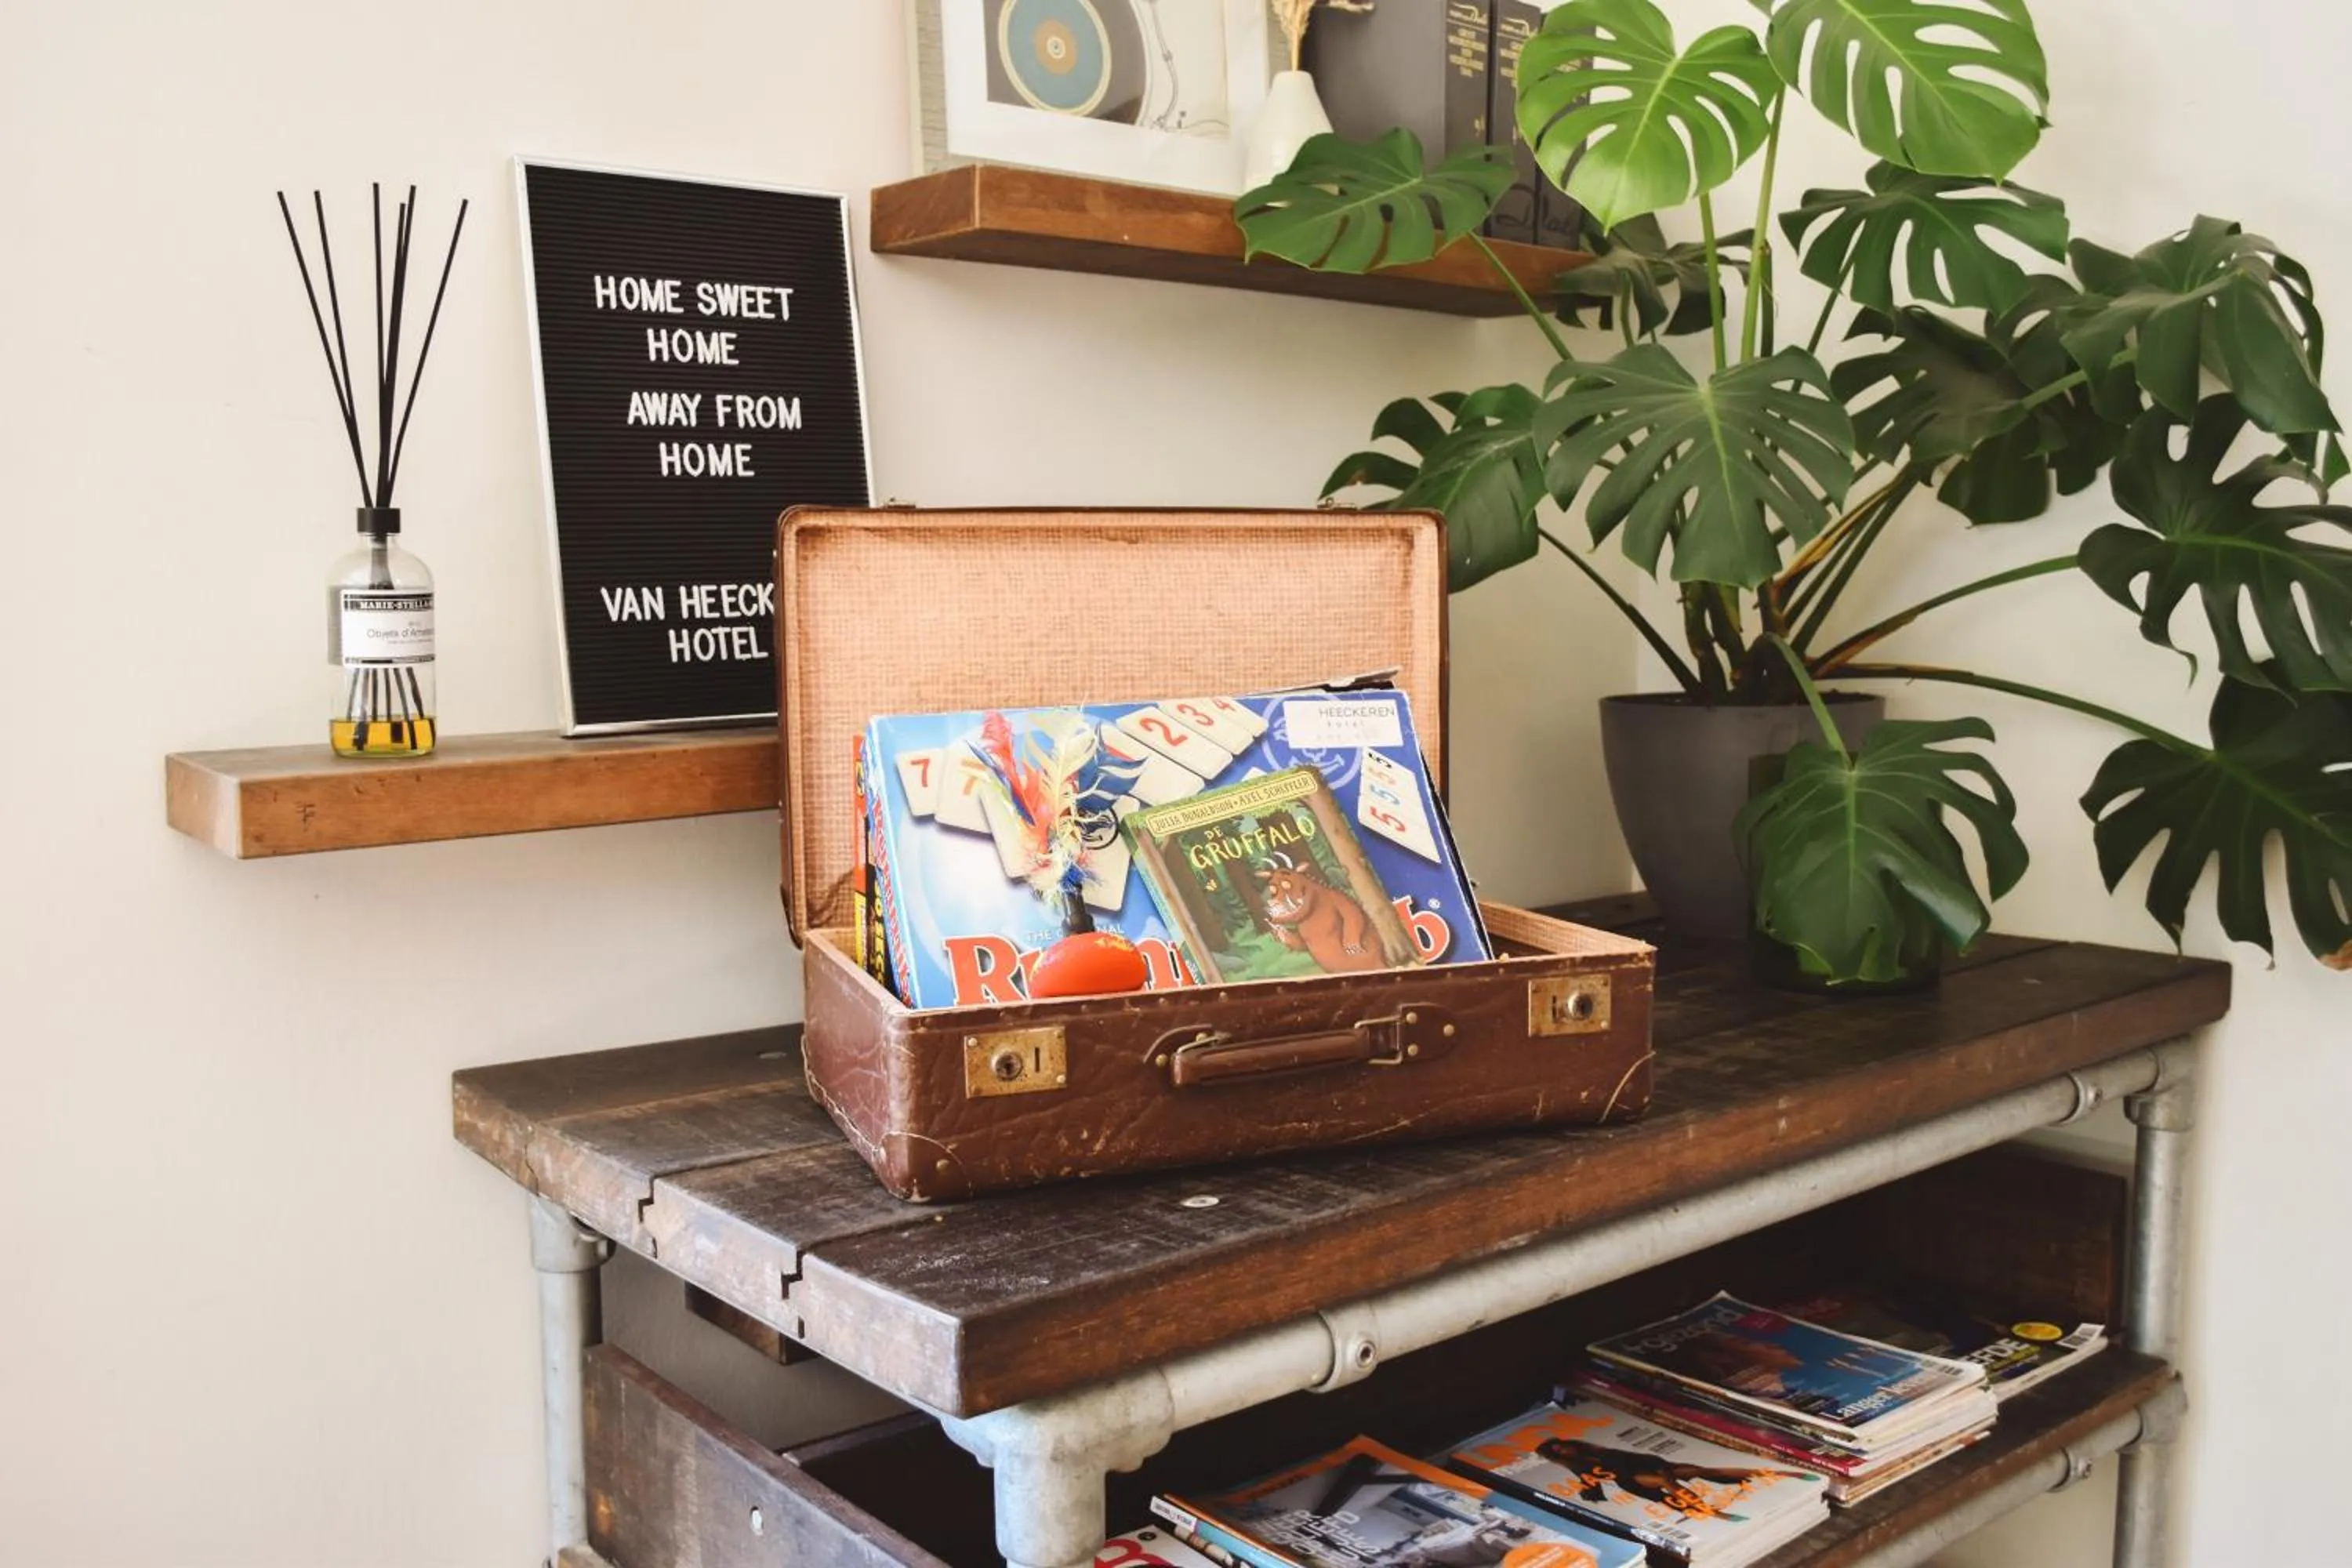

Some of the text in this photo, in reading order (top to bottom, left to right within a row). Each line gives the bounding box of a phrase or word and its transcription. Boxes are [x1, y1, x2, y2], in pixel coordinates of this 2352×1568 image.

[593, 275, 793, 320] HOME SWEET
[647, 328, 739, 365] HOME
[627, 392, 801, 430] AWAY FROM
[659, 443, 754, 477] HOME
[601, 586, 665, 622] VAN
[669, 626, 768, 662] HOTEL
[1139, 717, 1188, 747] 2
[1177, 703, 1214, 727] 3
[1319, 706, 1395, 717] HEECKEREN
[910, 758, 930, 788] 7
[1156, 815, 1180, 831] JULIA
[1240, 790, 1263, 807] AXEL
[1370, 806, 1406, 832] 5
[1189, 815, 1316, 869] GRUFFALO
[1203, 825, 1225, 840] DE
[1027, 930, 1053, 942] THE
